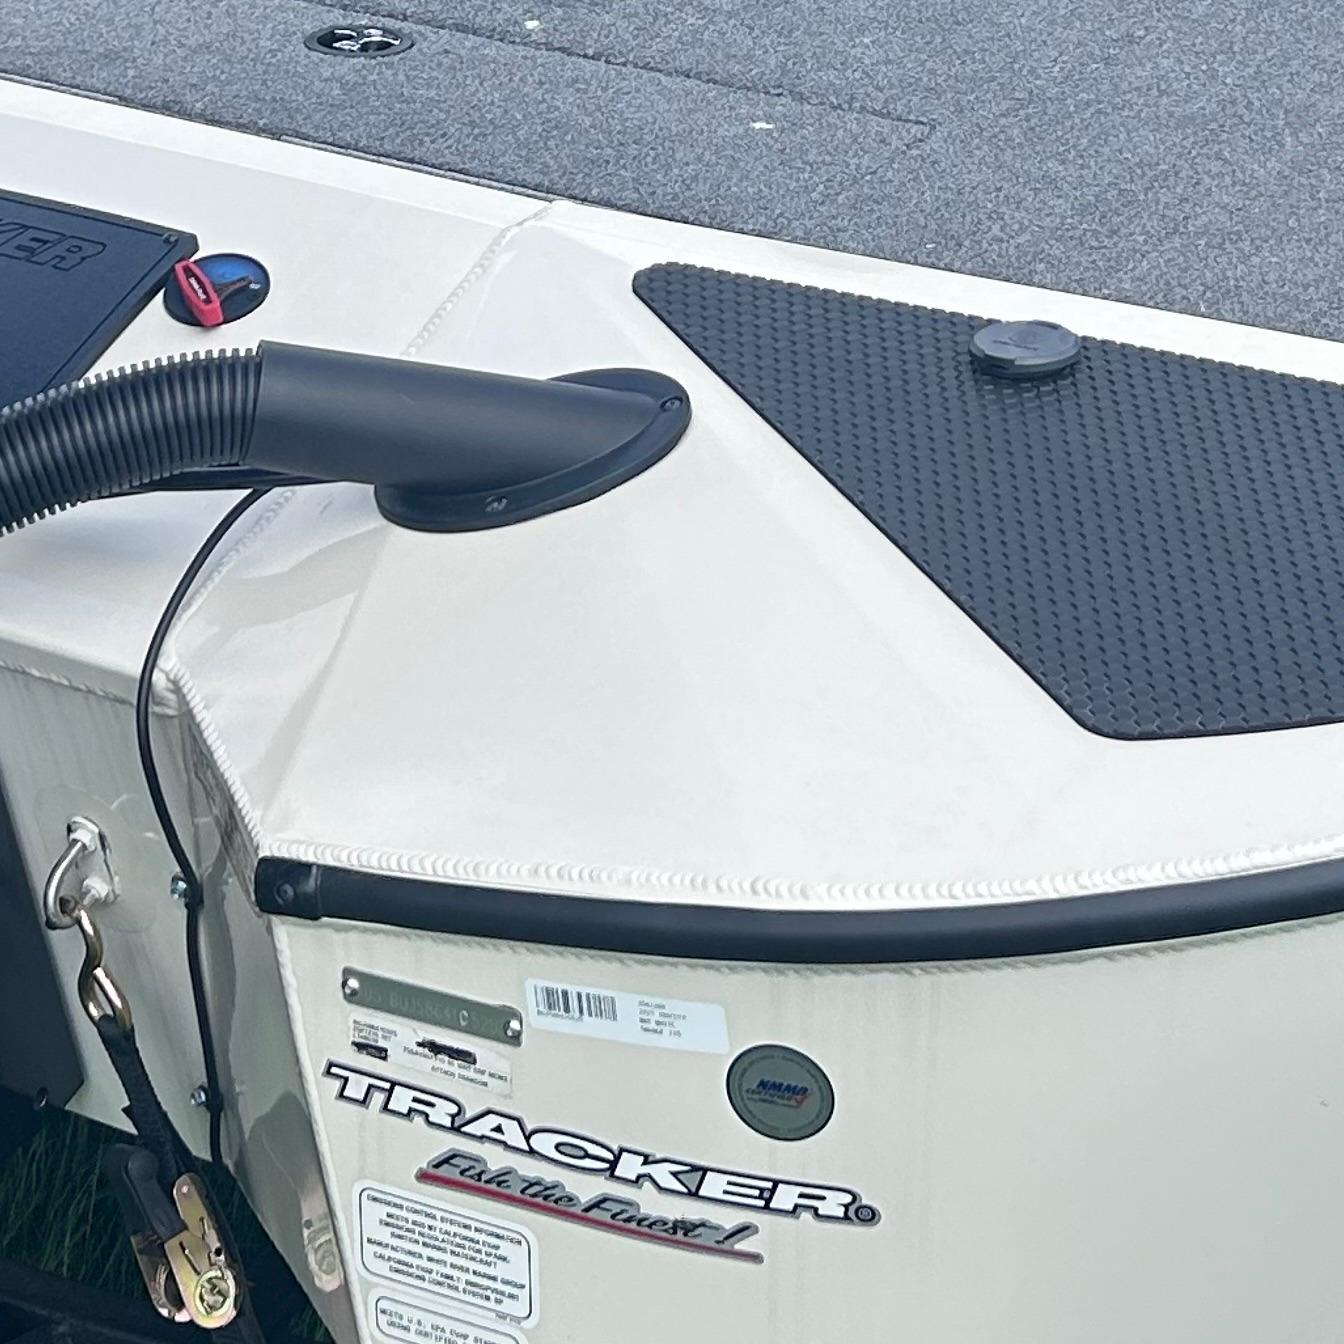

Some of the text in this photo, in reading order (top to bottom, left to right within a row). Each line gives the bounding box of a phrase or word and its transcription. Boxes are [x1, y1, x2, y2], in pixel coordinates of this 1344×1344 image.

[327, 1060, 862, 1222] TRACKER
[432, 1152, 512, 1191] Fish
[518, 1176, 578, 1207] the
[581, 1194, 709, 1241] Finest
